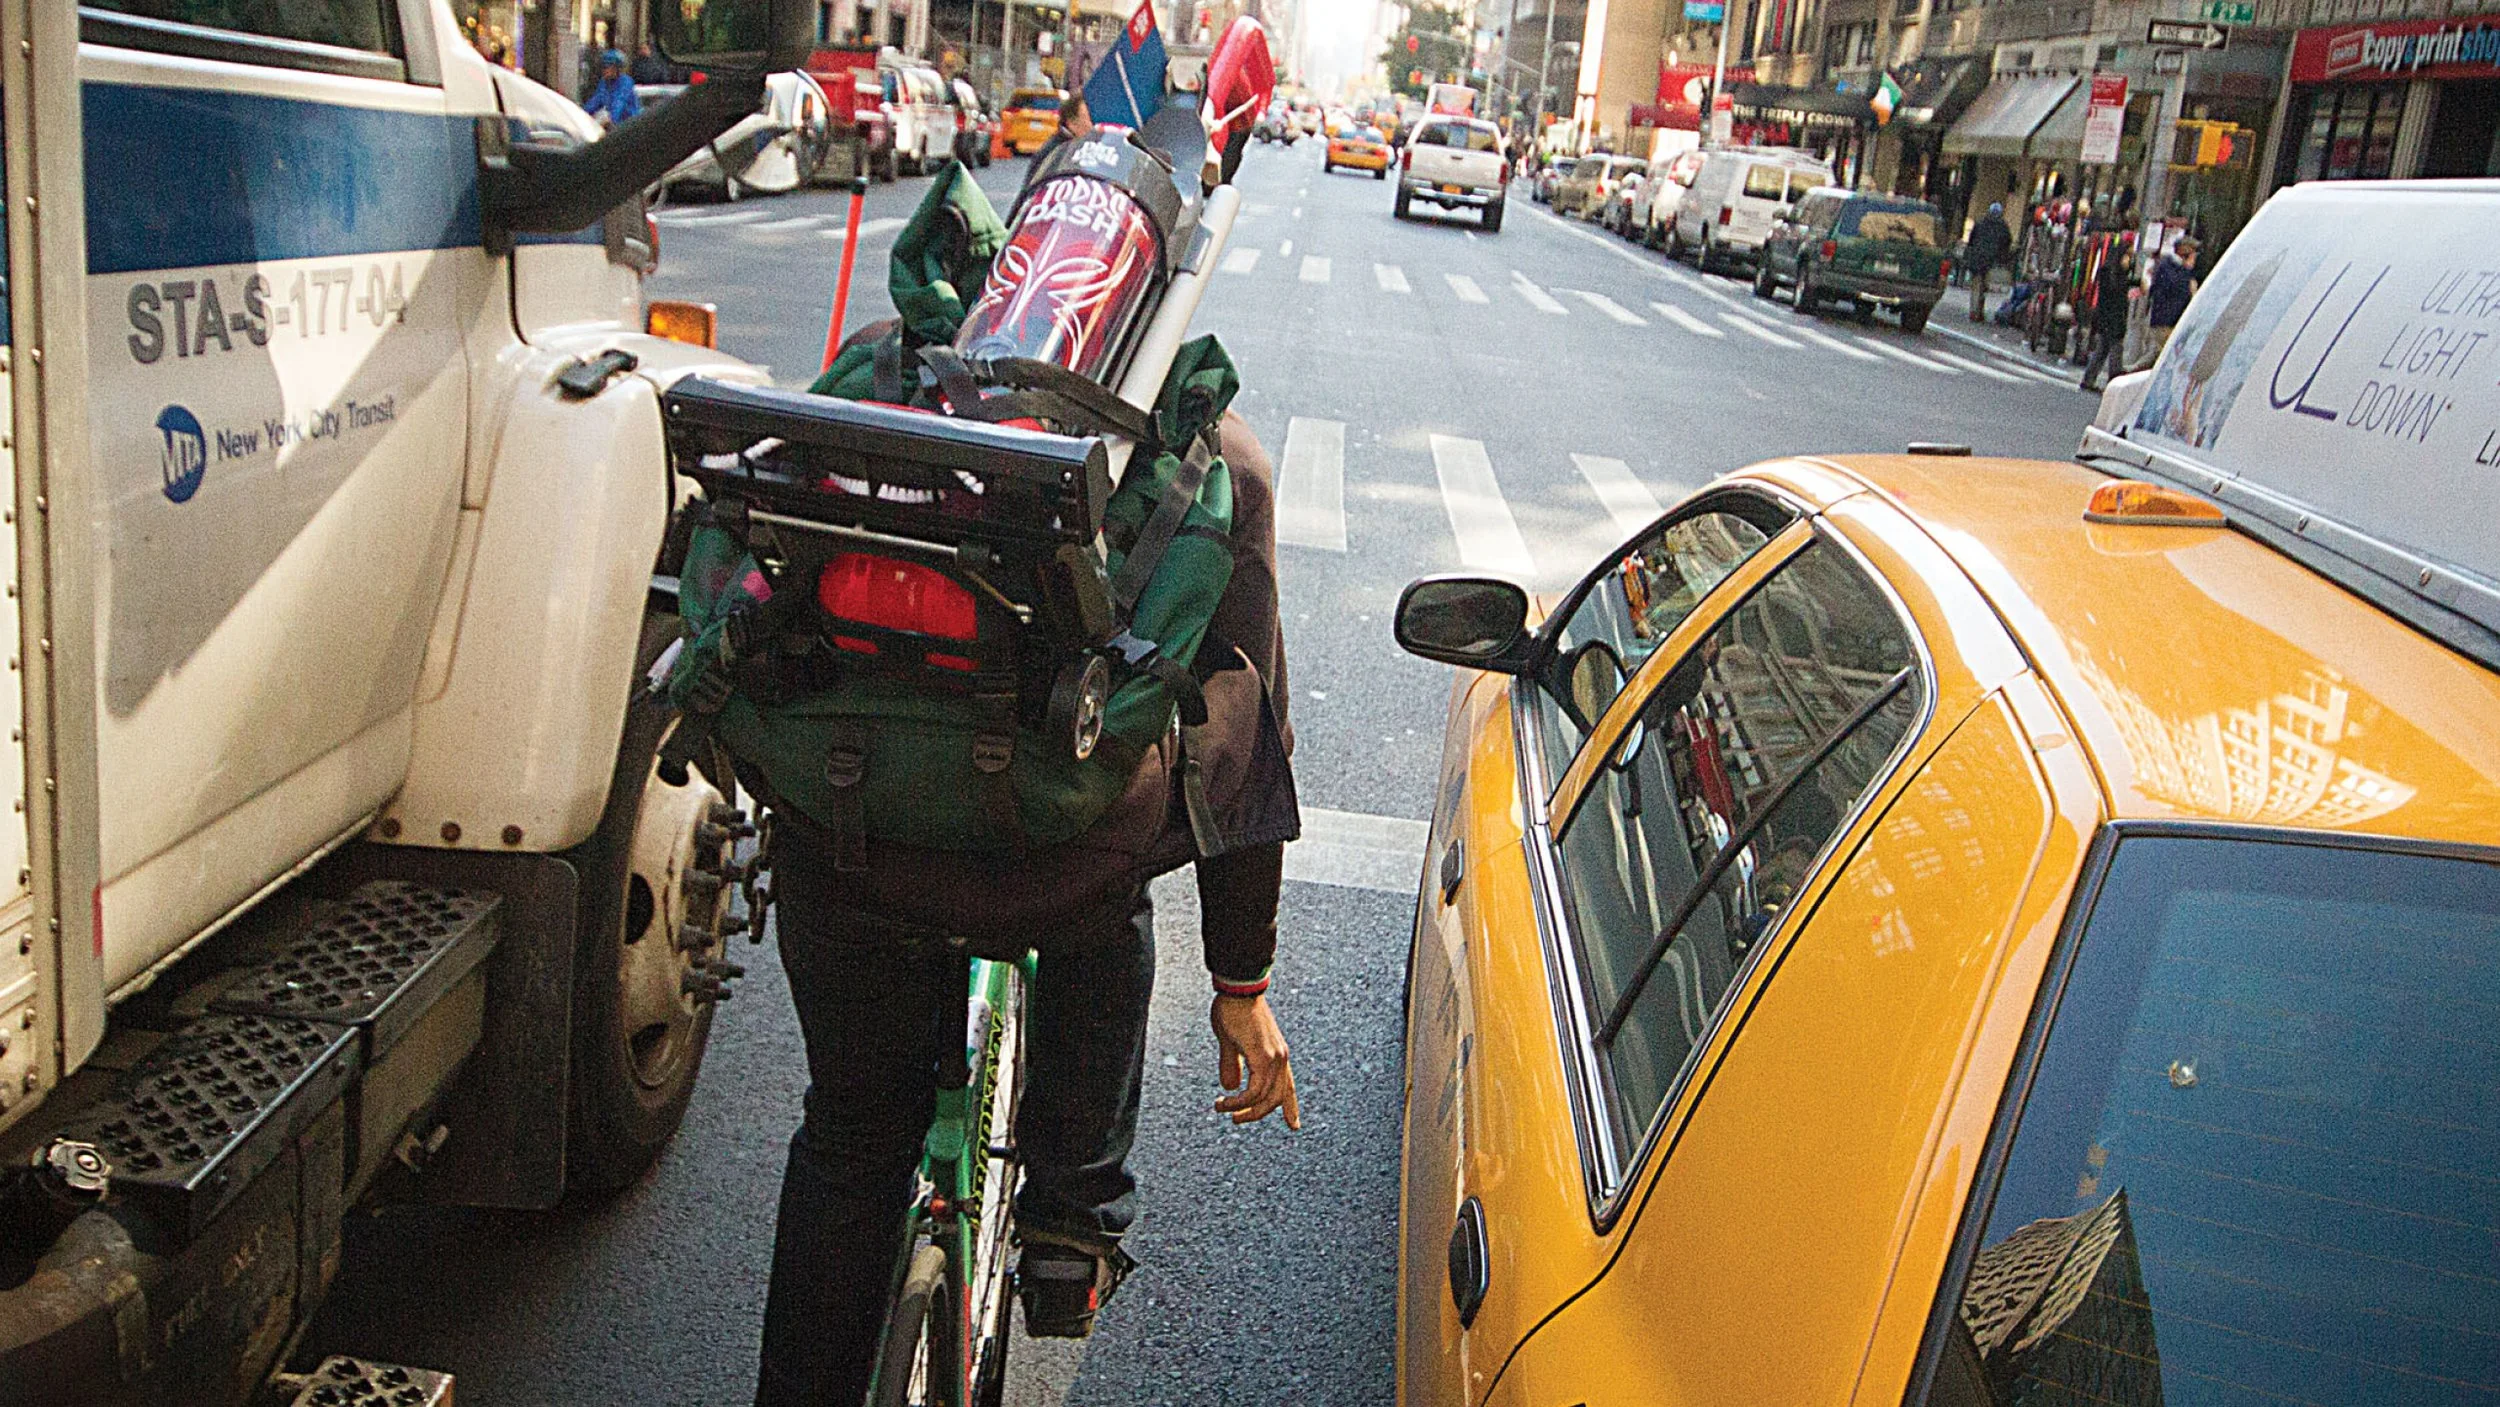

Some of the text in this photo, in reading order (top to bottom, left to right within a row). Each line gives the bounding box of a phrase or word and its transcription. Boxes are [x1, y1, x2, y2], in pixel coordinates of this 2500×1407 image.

[2160, 25, 2180, 40] ONE
[1732, 103, 1756, 117] THE
[1760, 107, 1804, 123] TRIPLE
[1807, 111, 1856, 127] CROWN
[1024, 202, 1119, 240] DASH
[127, 262, 406, 364] STA-S-177-04
[2379, 322, 2489, 380] LIGHT
[216, 393, 396, 461] New York City Transit
